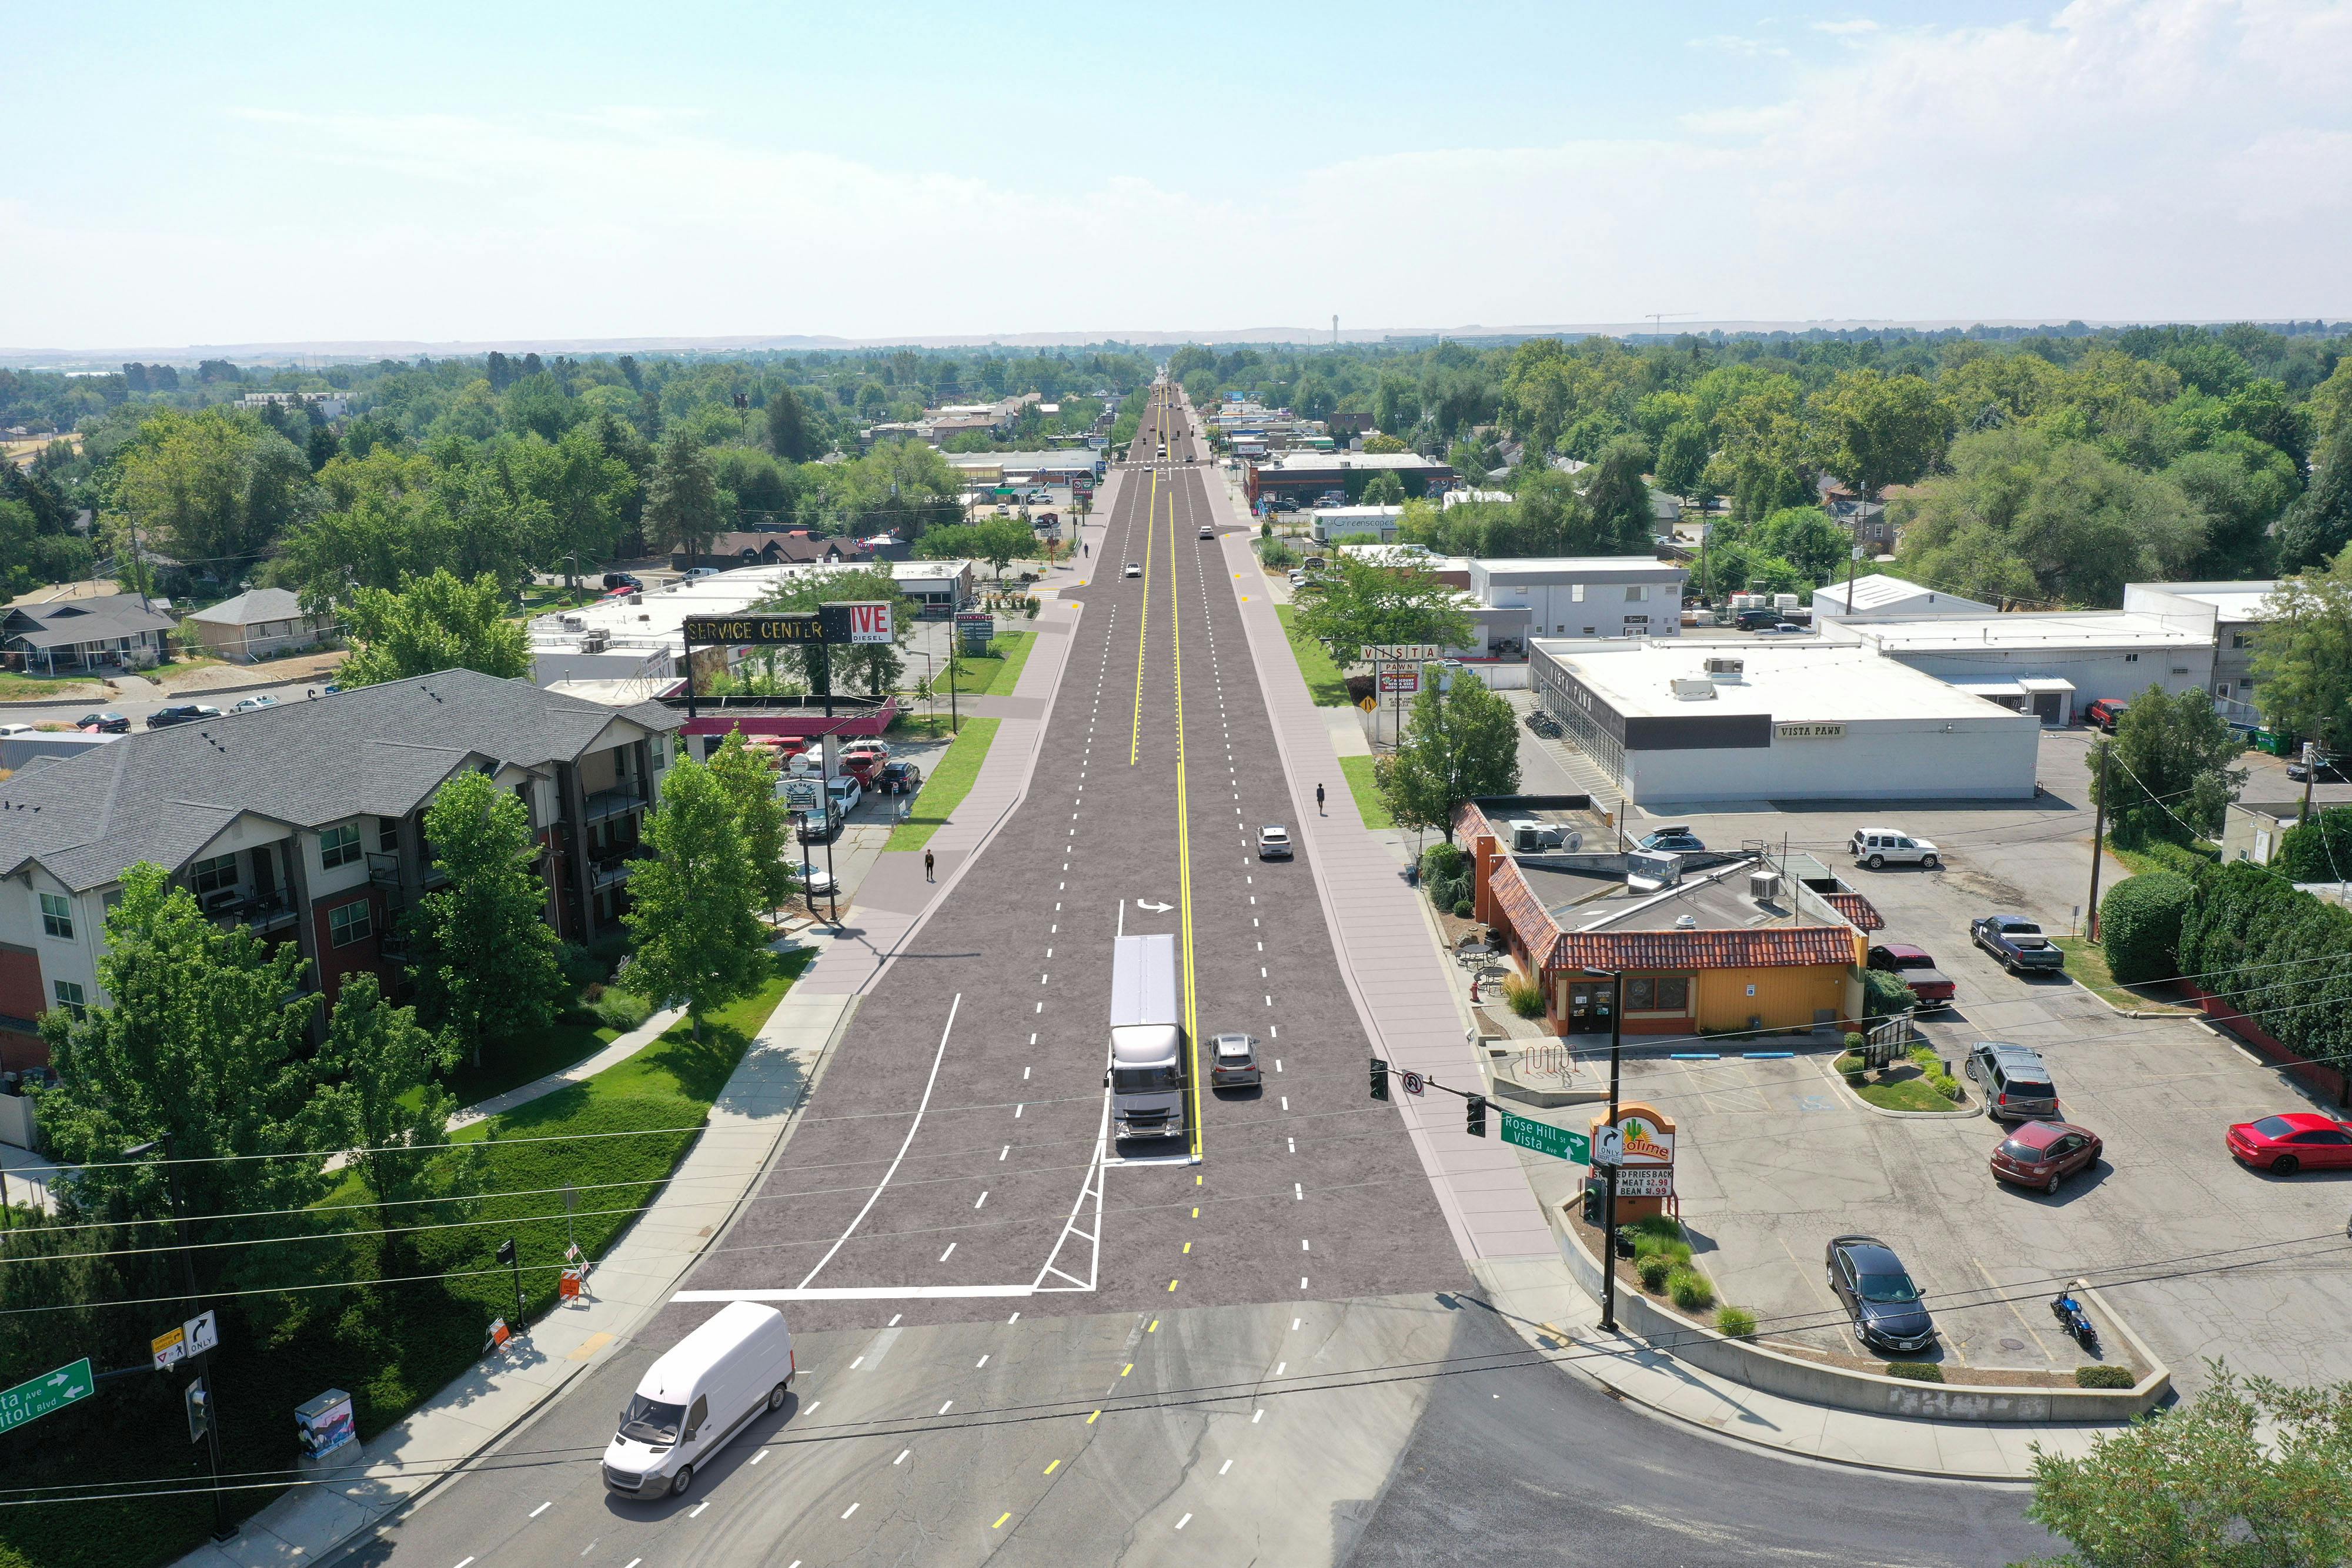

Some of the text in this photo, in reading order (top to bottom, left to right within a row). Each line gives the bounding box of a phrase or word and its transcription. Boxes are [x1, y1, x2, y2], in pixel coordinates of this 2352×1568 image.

[688, 621, 822, 640] SERVICE CENTER
[1365, 648, 1434, 658] VISTA
[1550, 667, 1592, 712] VISTA PAWN
[1781, 727, 1840, 735] VISTA PAWN
[1505, 1115, 1533, 1134] Rose
[1536, 1124, 1556, 1141] Hill
[1514, 1131, 1557, 1154] Vista Ave
[1601, 1147, 1620, 1157] ONLY
[1598, 1154, 1622, 1165] EXCEPT BUSES
[191, 1336, 212, 1352] ONLY
[25, 1388, 42, 1400] Ave
[36, 1398, 56, 1412] Blvd
